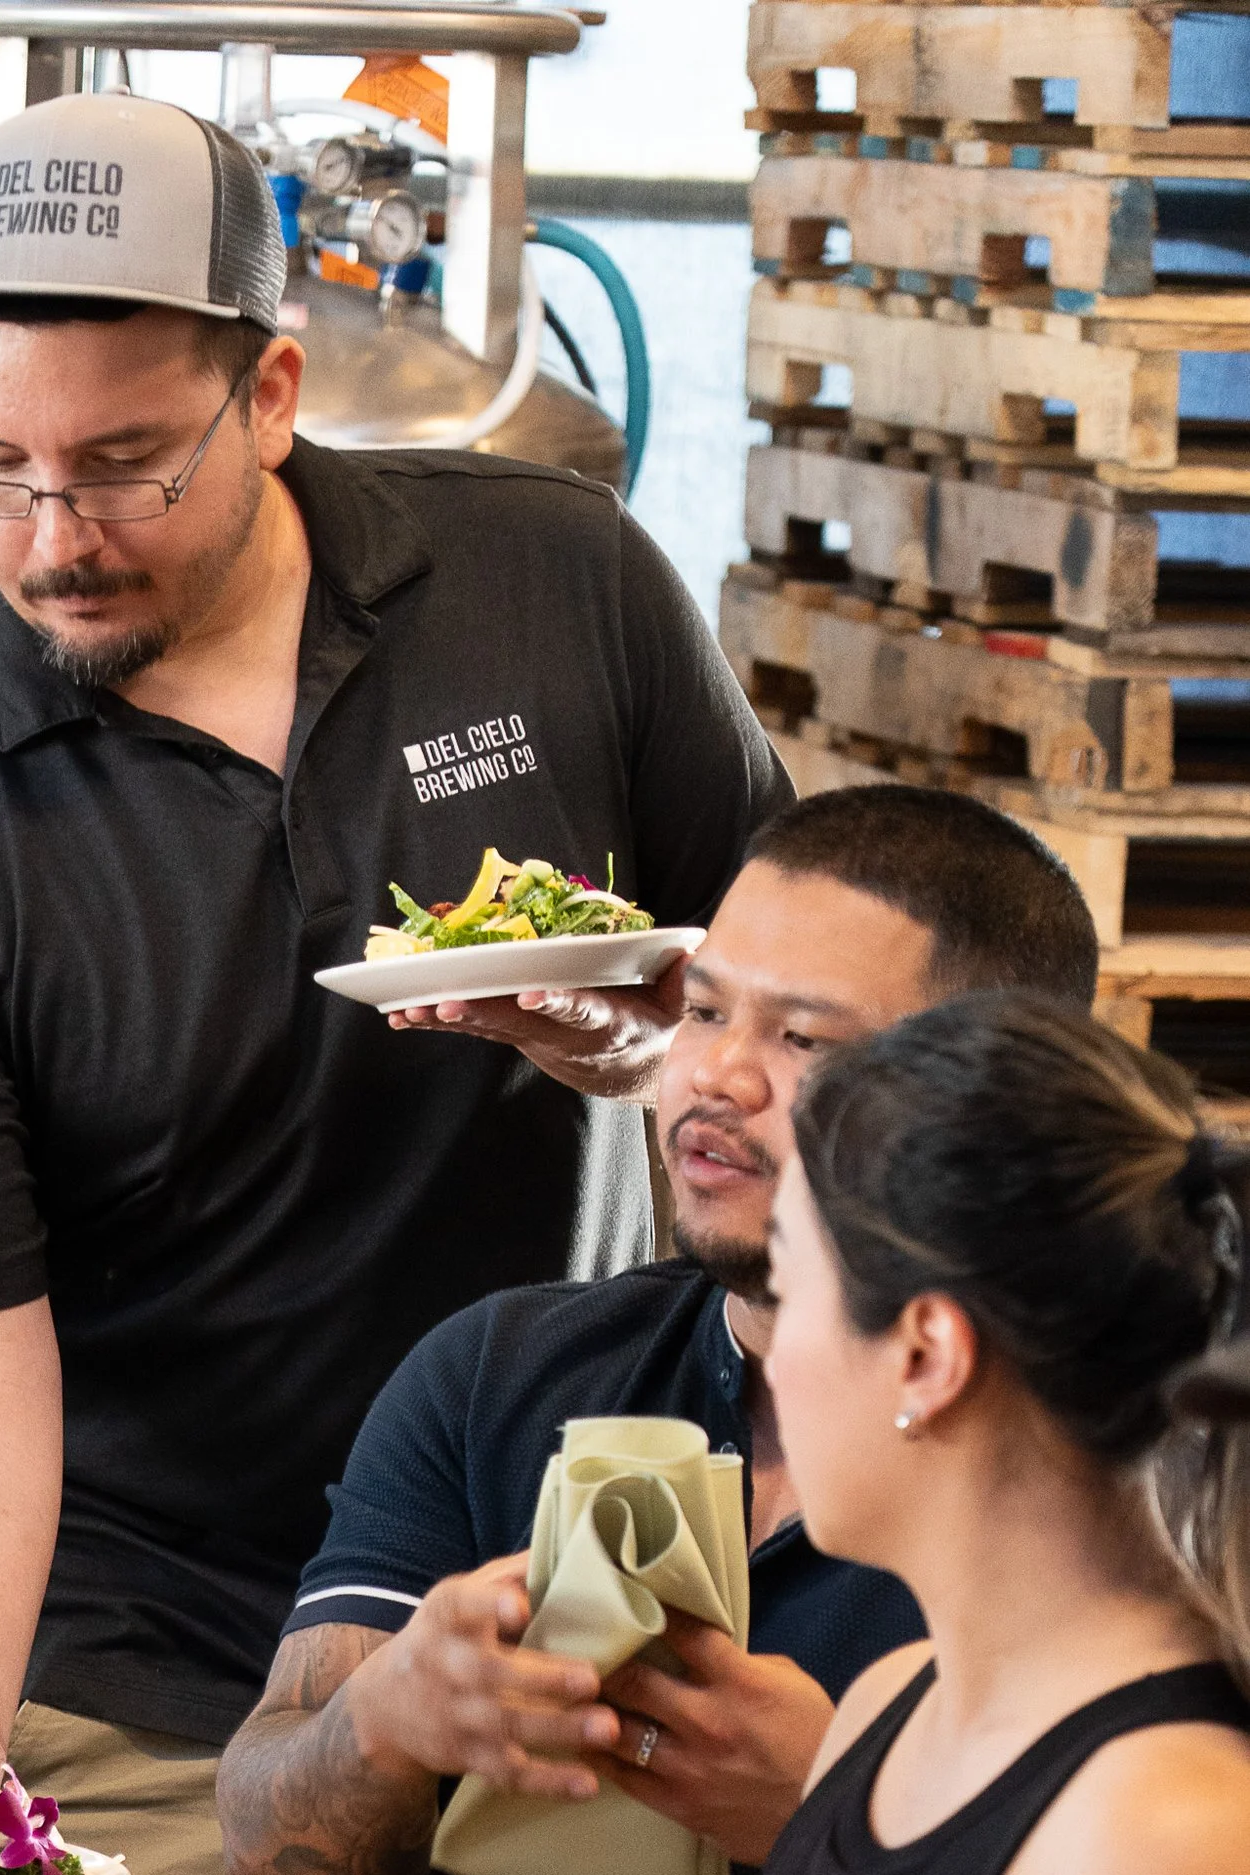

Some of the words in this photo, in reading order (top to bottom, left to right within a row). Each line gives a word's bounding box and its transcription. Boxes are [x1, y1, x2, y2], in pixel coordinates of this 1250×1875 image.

[44, 158, 123, 196] CIELO
[424, 733, 469, 767] DEL
[467, 714, 526, 752] CIELO
[413, 753, 510, 803] BREWING
